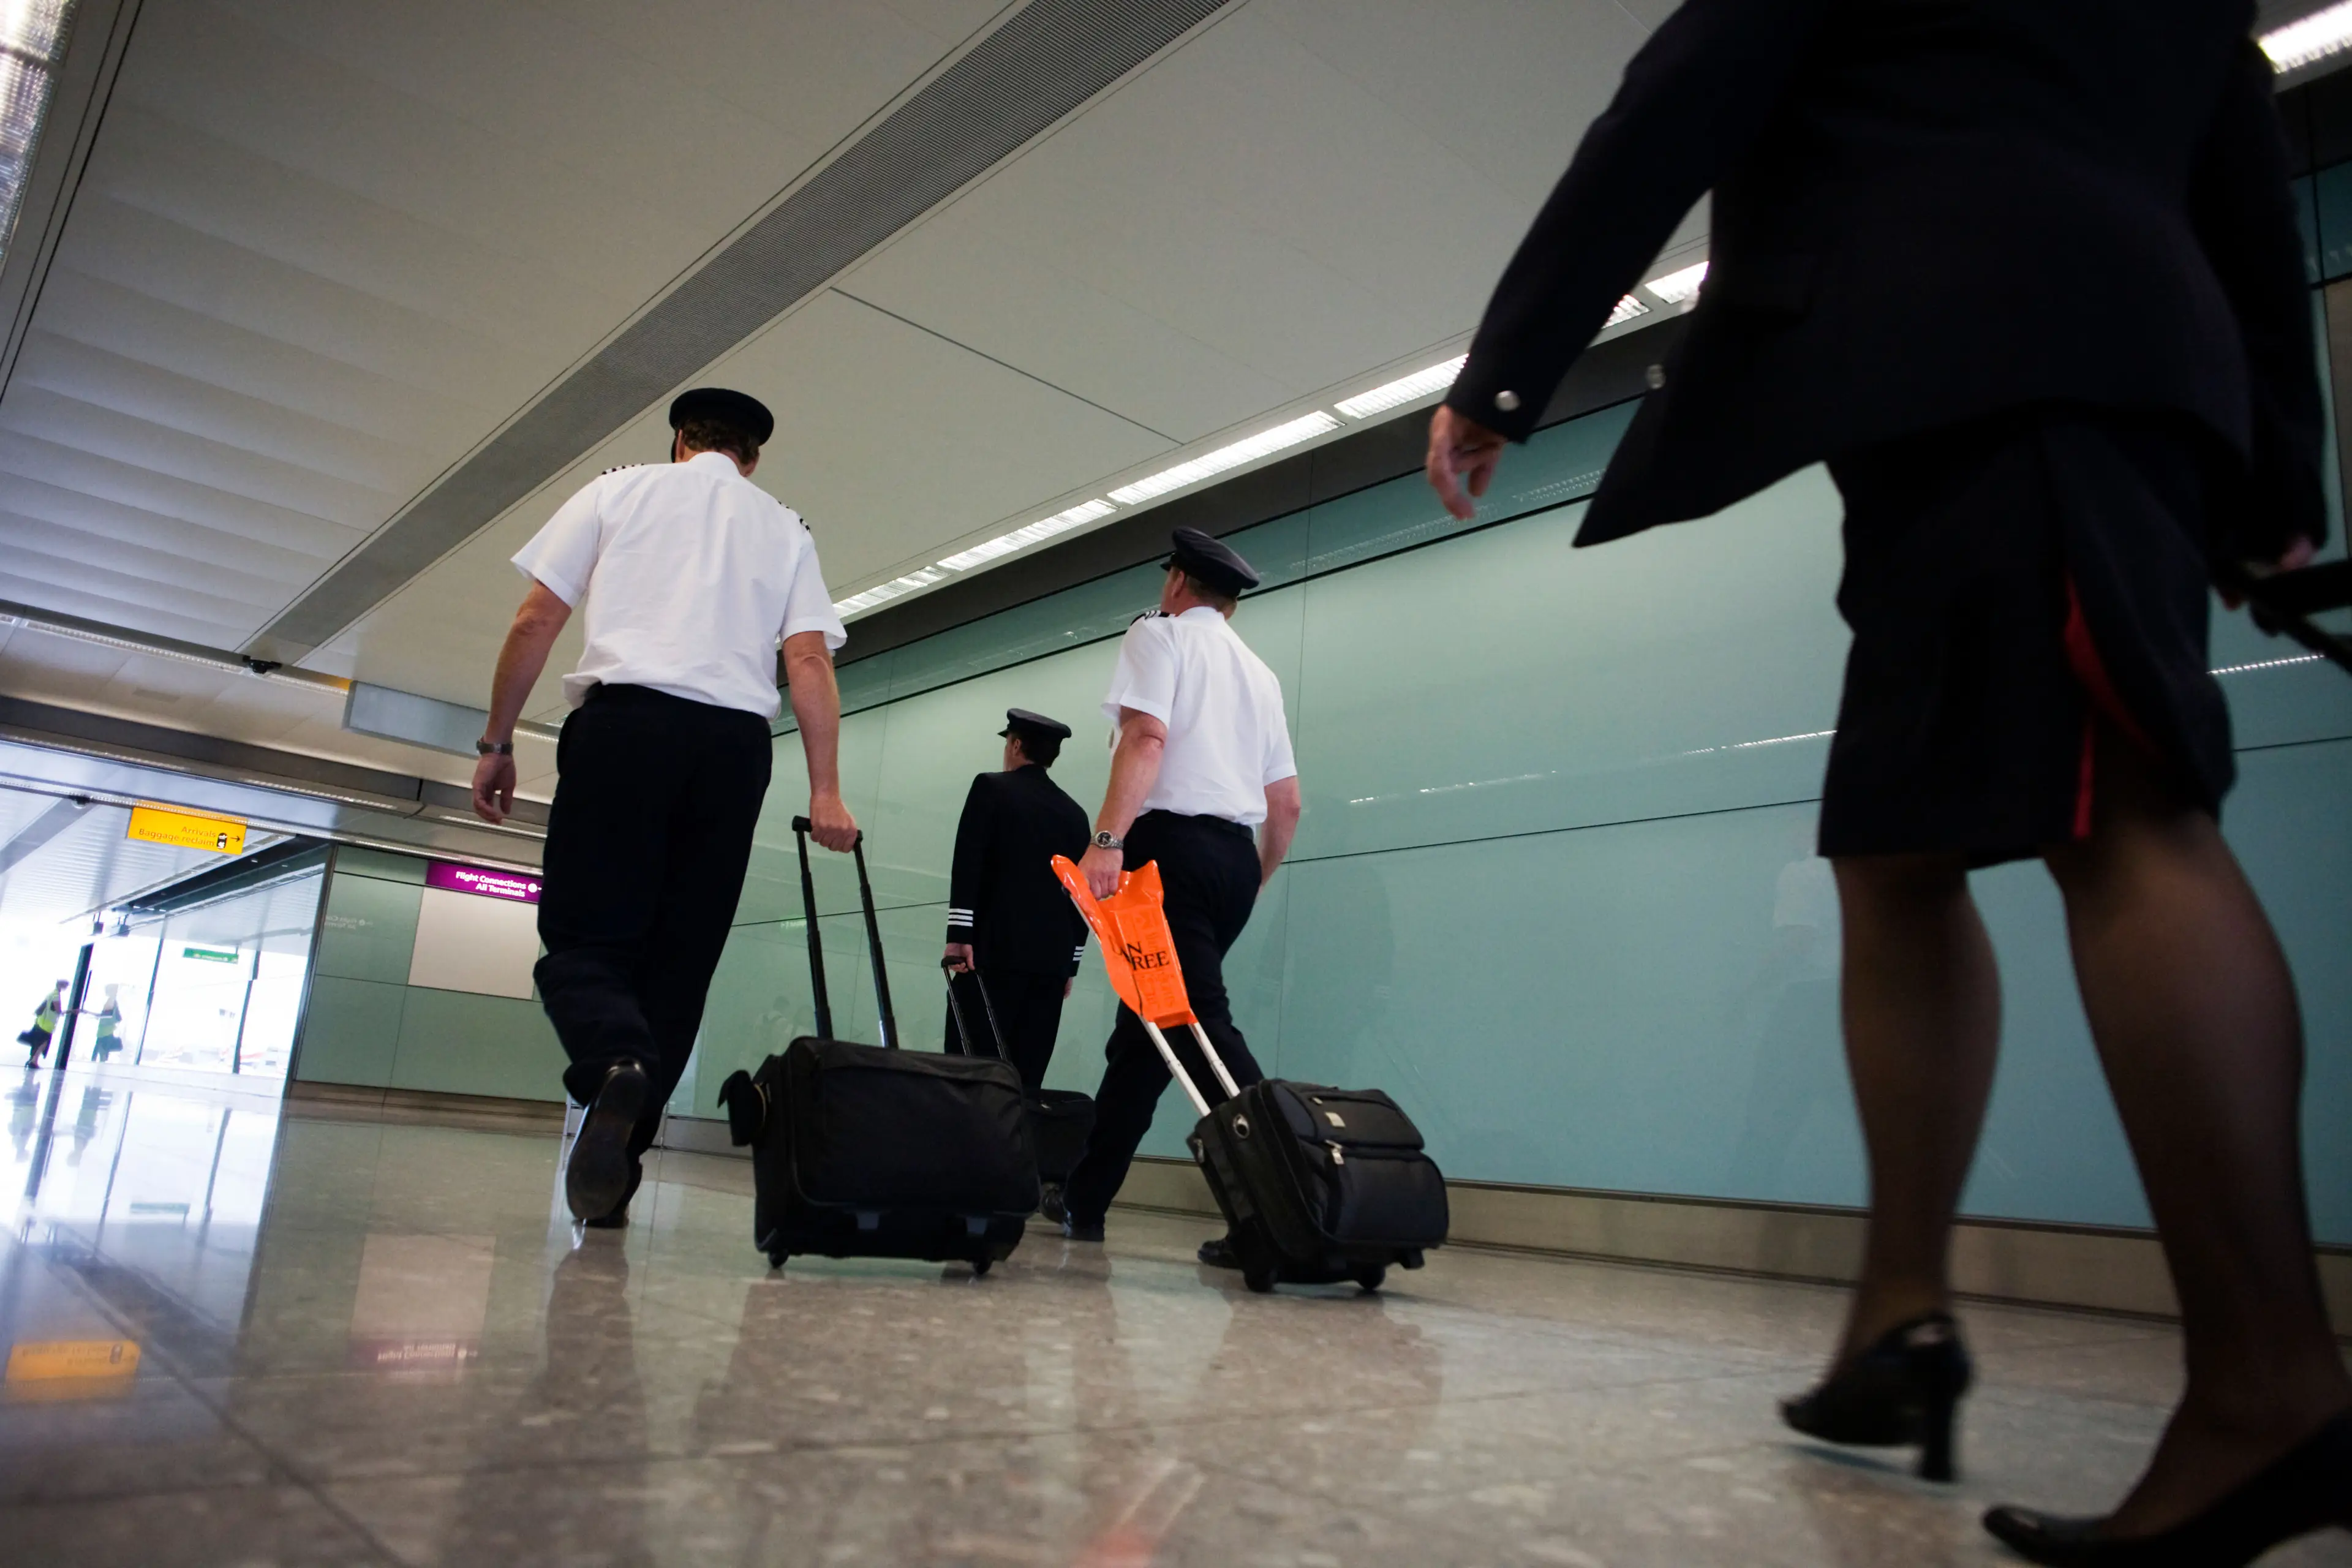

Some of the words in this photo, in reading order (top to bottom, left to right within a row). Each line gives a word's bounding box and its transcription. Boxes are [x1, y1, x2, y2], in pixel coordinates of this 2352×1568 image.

[139, 828, 179, 842] Baggage
[182, 835, 214, 846] reclaim
[181, 826, 216, 838] Arrivals
[456, 871, 479, 882] Flight
[480, 875, 527, 890] Connections
[488, 886, 526, 897] Terminals
